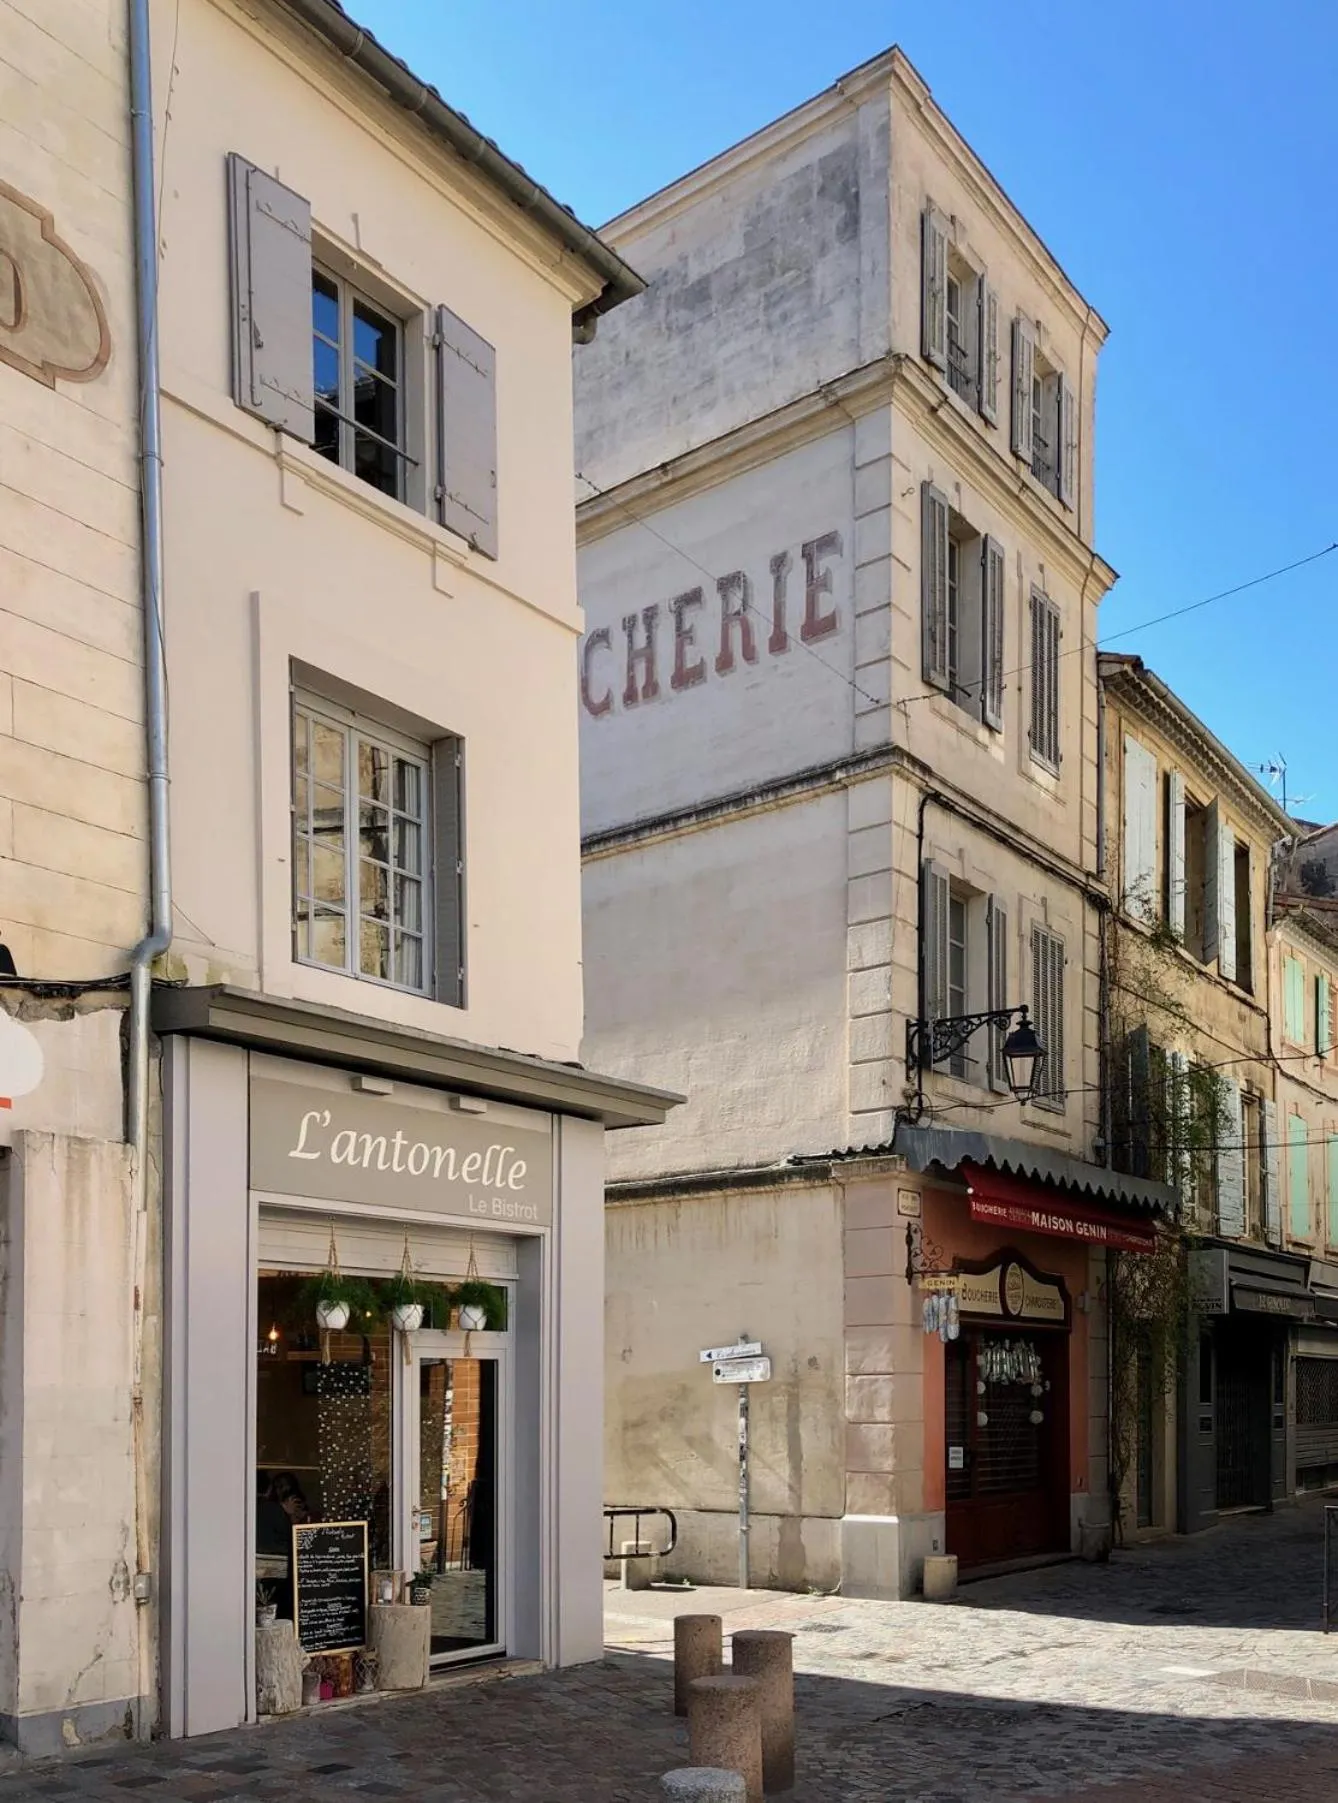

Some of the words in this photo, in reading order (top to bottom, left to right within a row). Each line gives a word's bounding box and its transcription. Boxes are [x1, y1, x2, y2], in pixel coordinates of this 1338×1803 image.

[581, 531, 844, 717] CHERIE
[288, 1110, 528, 1191] L'antonelle
[469, 1194, 488, 1214] Le
[492, 1196, 538, 1221] Bistrot
[1031, 1211, 1074, 1233] MAISON
[1075, 1222, 1107, 1239] GENIN
[926, 1279, 956, 1287] GENIN
[962, 1283, 998, 1304] BOUCHERIE
